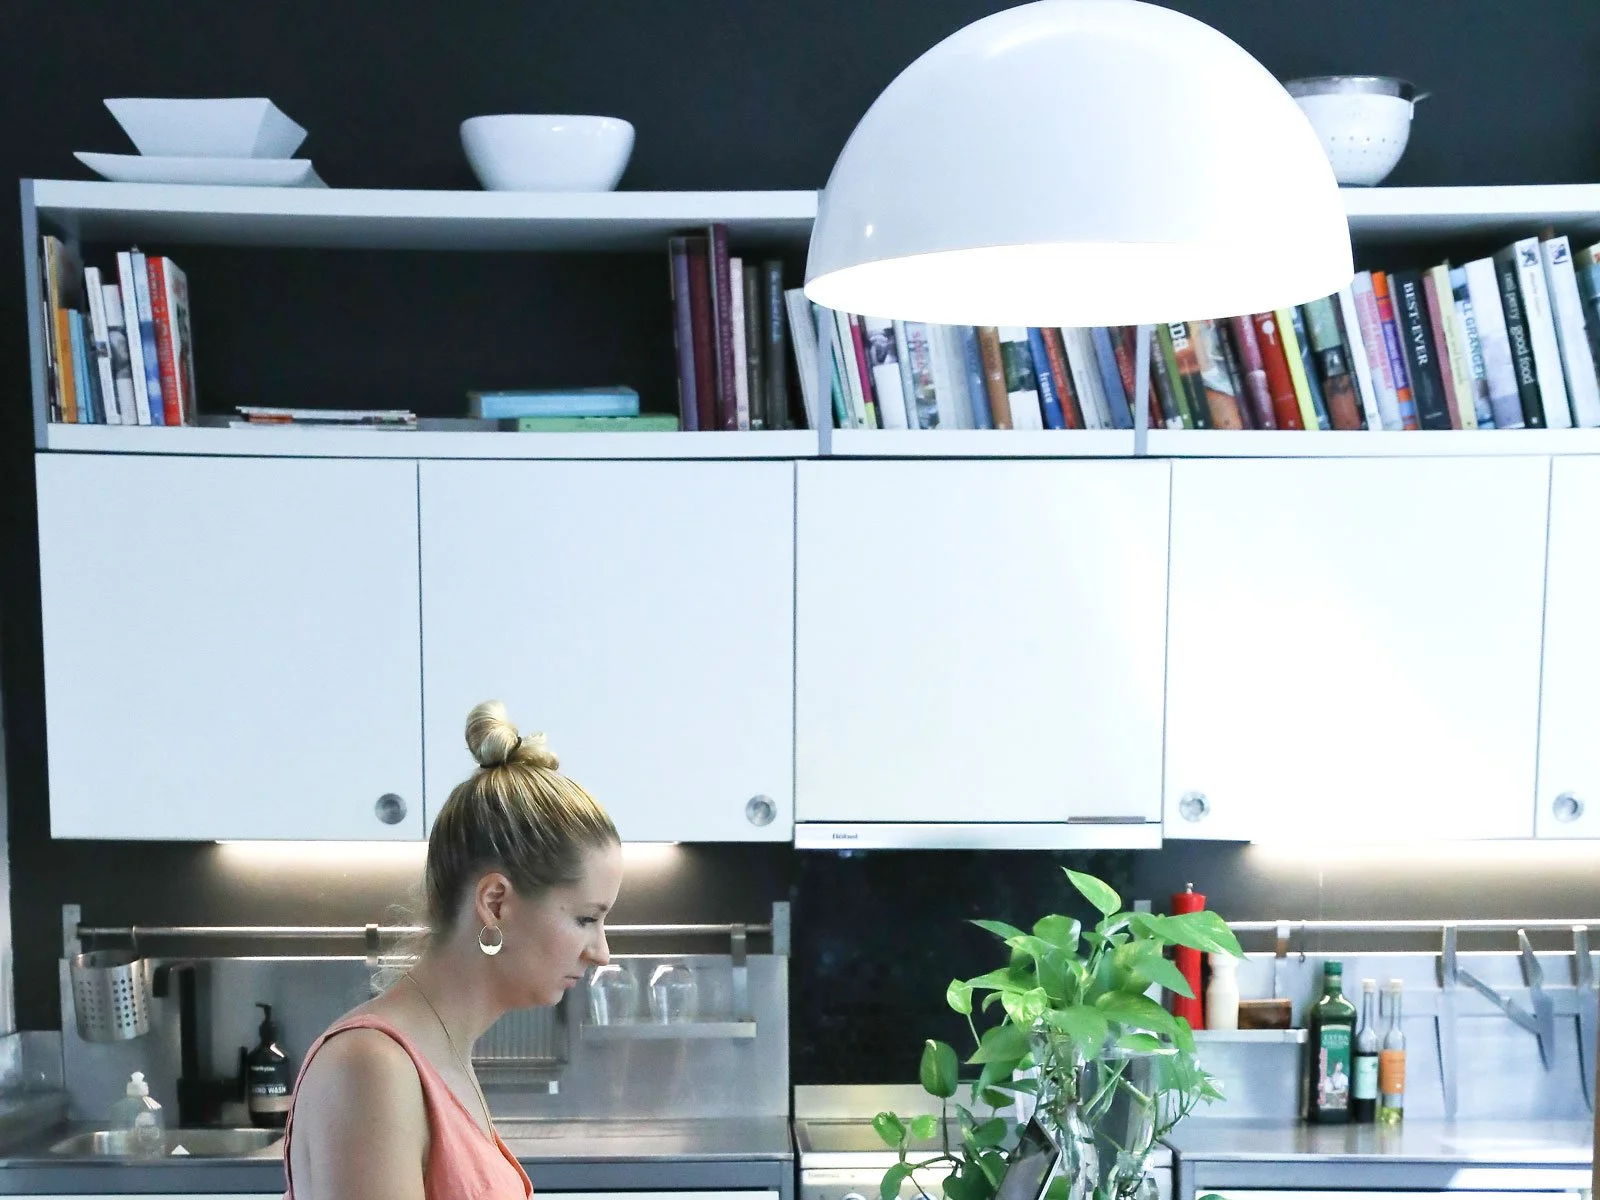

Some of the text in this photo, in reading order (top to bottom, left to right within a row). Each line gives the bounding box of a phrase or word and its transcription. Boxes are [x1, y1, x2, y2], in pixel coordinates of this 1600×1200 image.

[1505, 292, 1522, 321] perry
[1403, 281, 1428, 367] BEST-EVER
[1464, 316, 1485, 381] GRANGER
[1511, 324, 1528, 356] good
[1519, 356, 1536, 385] food
[267, 1085, 287, 1094] WASH
